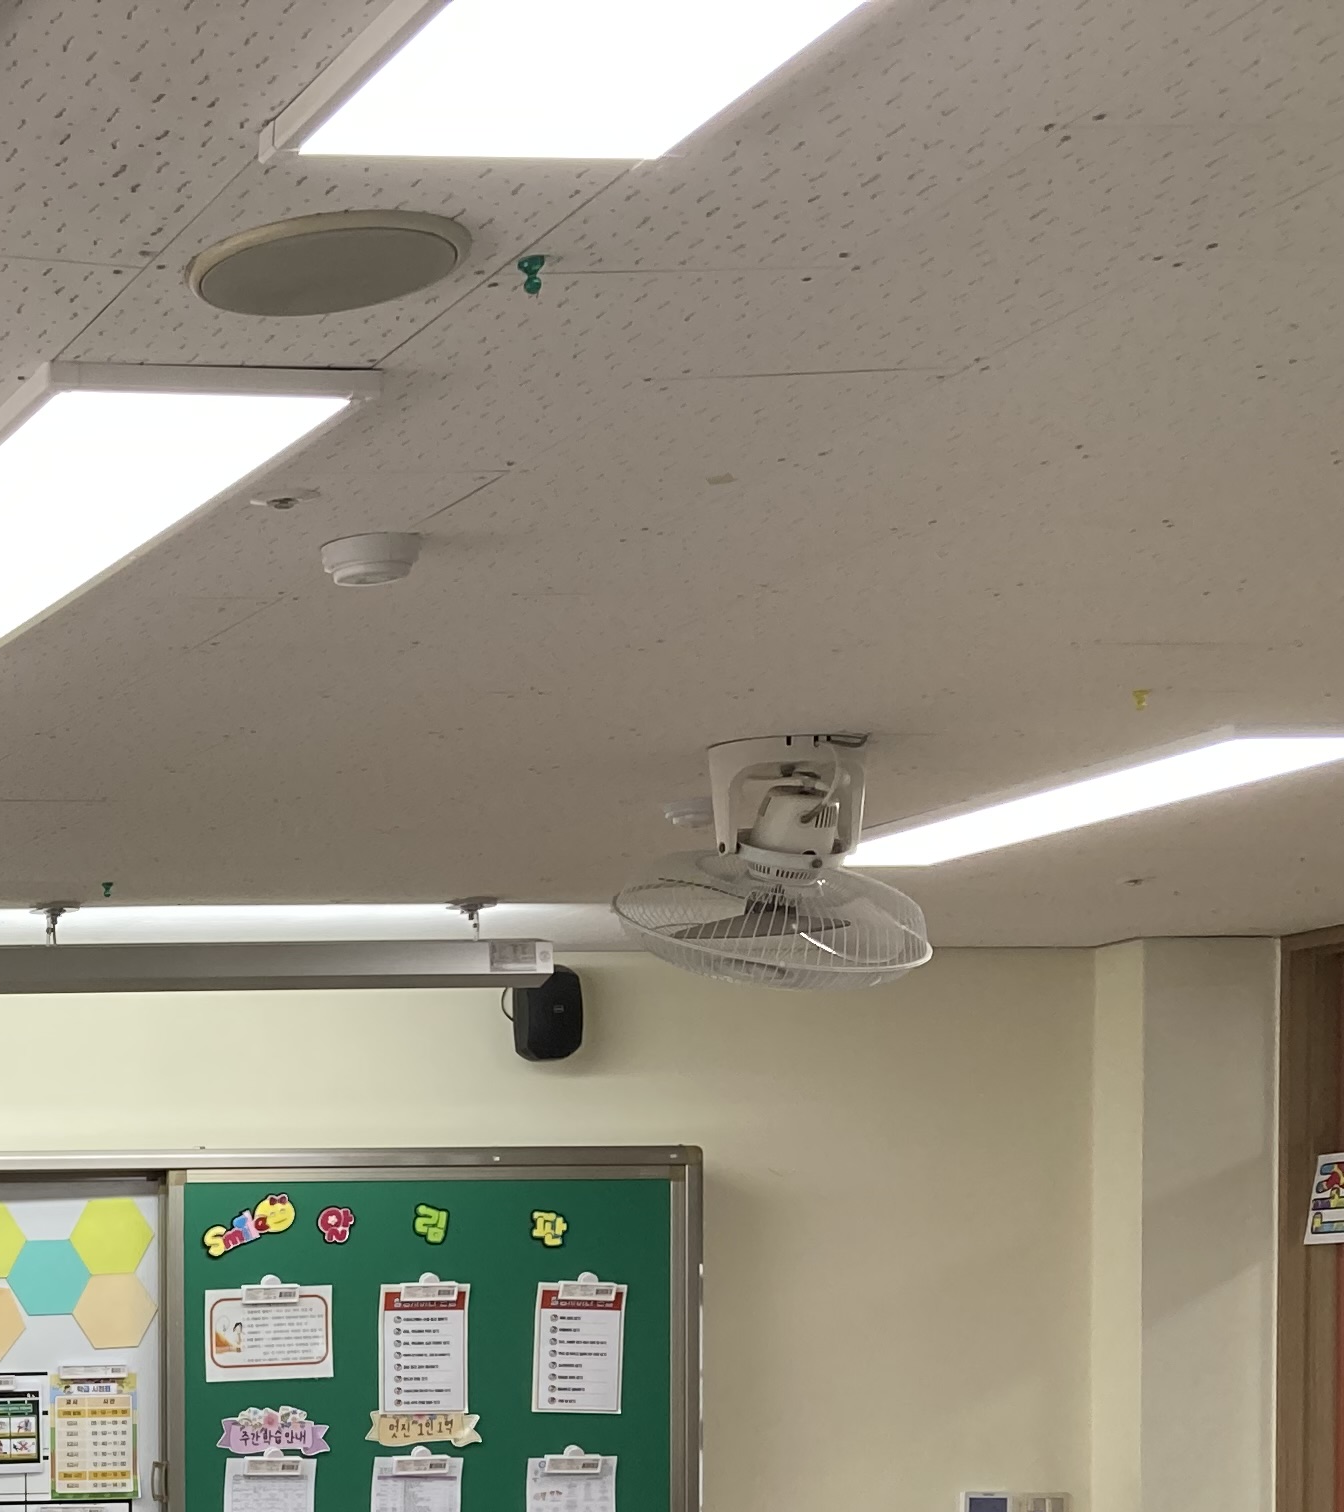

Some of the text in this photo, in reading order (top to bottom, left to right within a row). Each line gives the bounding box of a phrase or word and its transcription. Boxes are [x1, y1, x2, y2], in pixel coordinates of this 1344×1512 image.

[318, 1205, 567, 1246] 알 림 판
[418, 1419, 433, 1436] 1인
[239, 1428, 306, 1446] 주간 학습 안내
